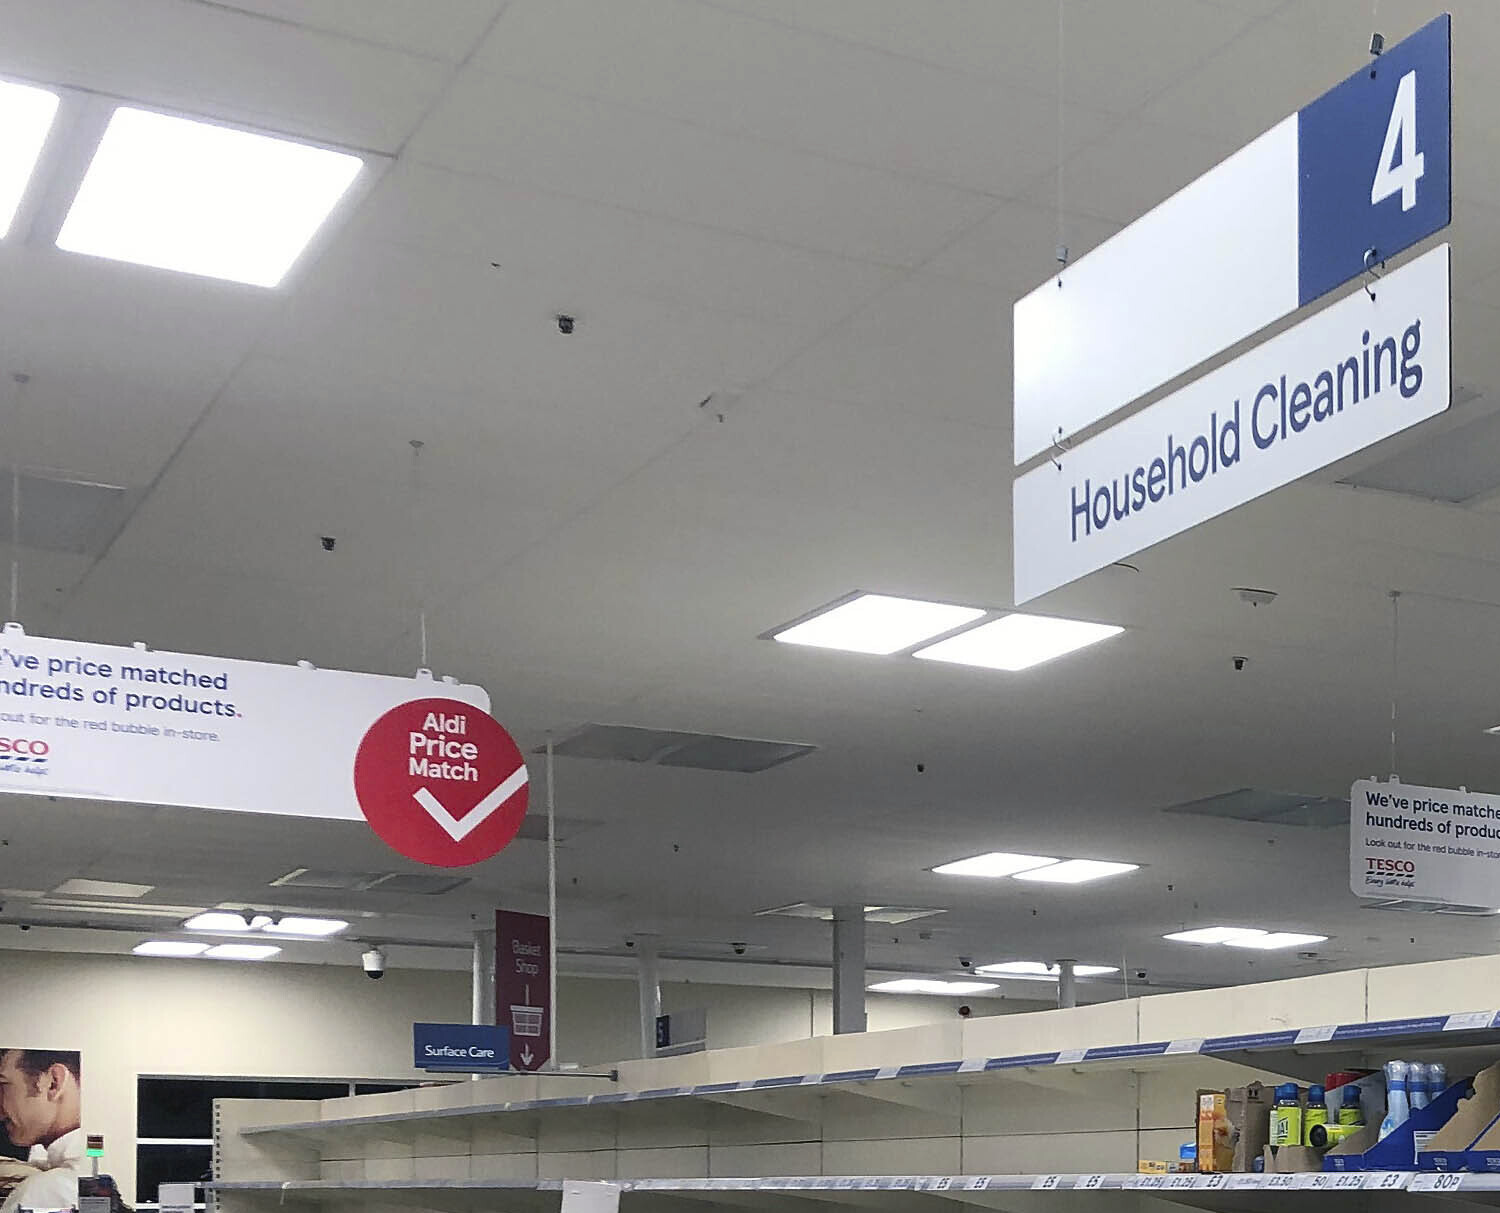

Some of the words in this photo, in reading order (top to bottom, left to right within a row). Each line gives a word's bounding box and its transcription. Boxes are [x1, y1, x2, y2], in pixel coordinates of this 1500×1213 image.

[1371, 70, 1424, 212] 4
[1071, 401, 1240, 542] Household
[1251, 318, 1423, 449] Cleaning
[0, 649, 39, 671] 've
[48, 656, 112, 678] price
[121, 667, 228, 691] matched
[92, 687, 117, 705] of
[126, 693, 242, 718] products.
[423, 712, 466, 735] Aldi
[410, 732, 477, 761] Price
[409, 757, 478, 782] Match
[1366, 791, 1408, 809] We've
[1413, 798, 1448, 814] price
[1366, 812, 1433, 832] hundreds
[1437, 820, 1452, 834] of
[1366, 857, 1415, 873] TESCO
[425, 1045, 467, 1058] Surface
[469, 1046, 494, 1058] Care
[1380, 1174, 1397, 1188] £3
